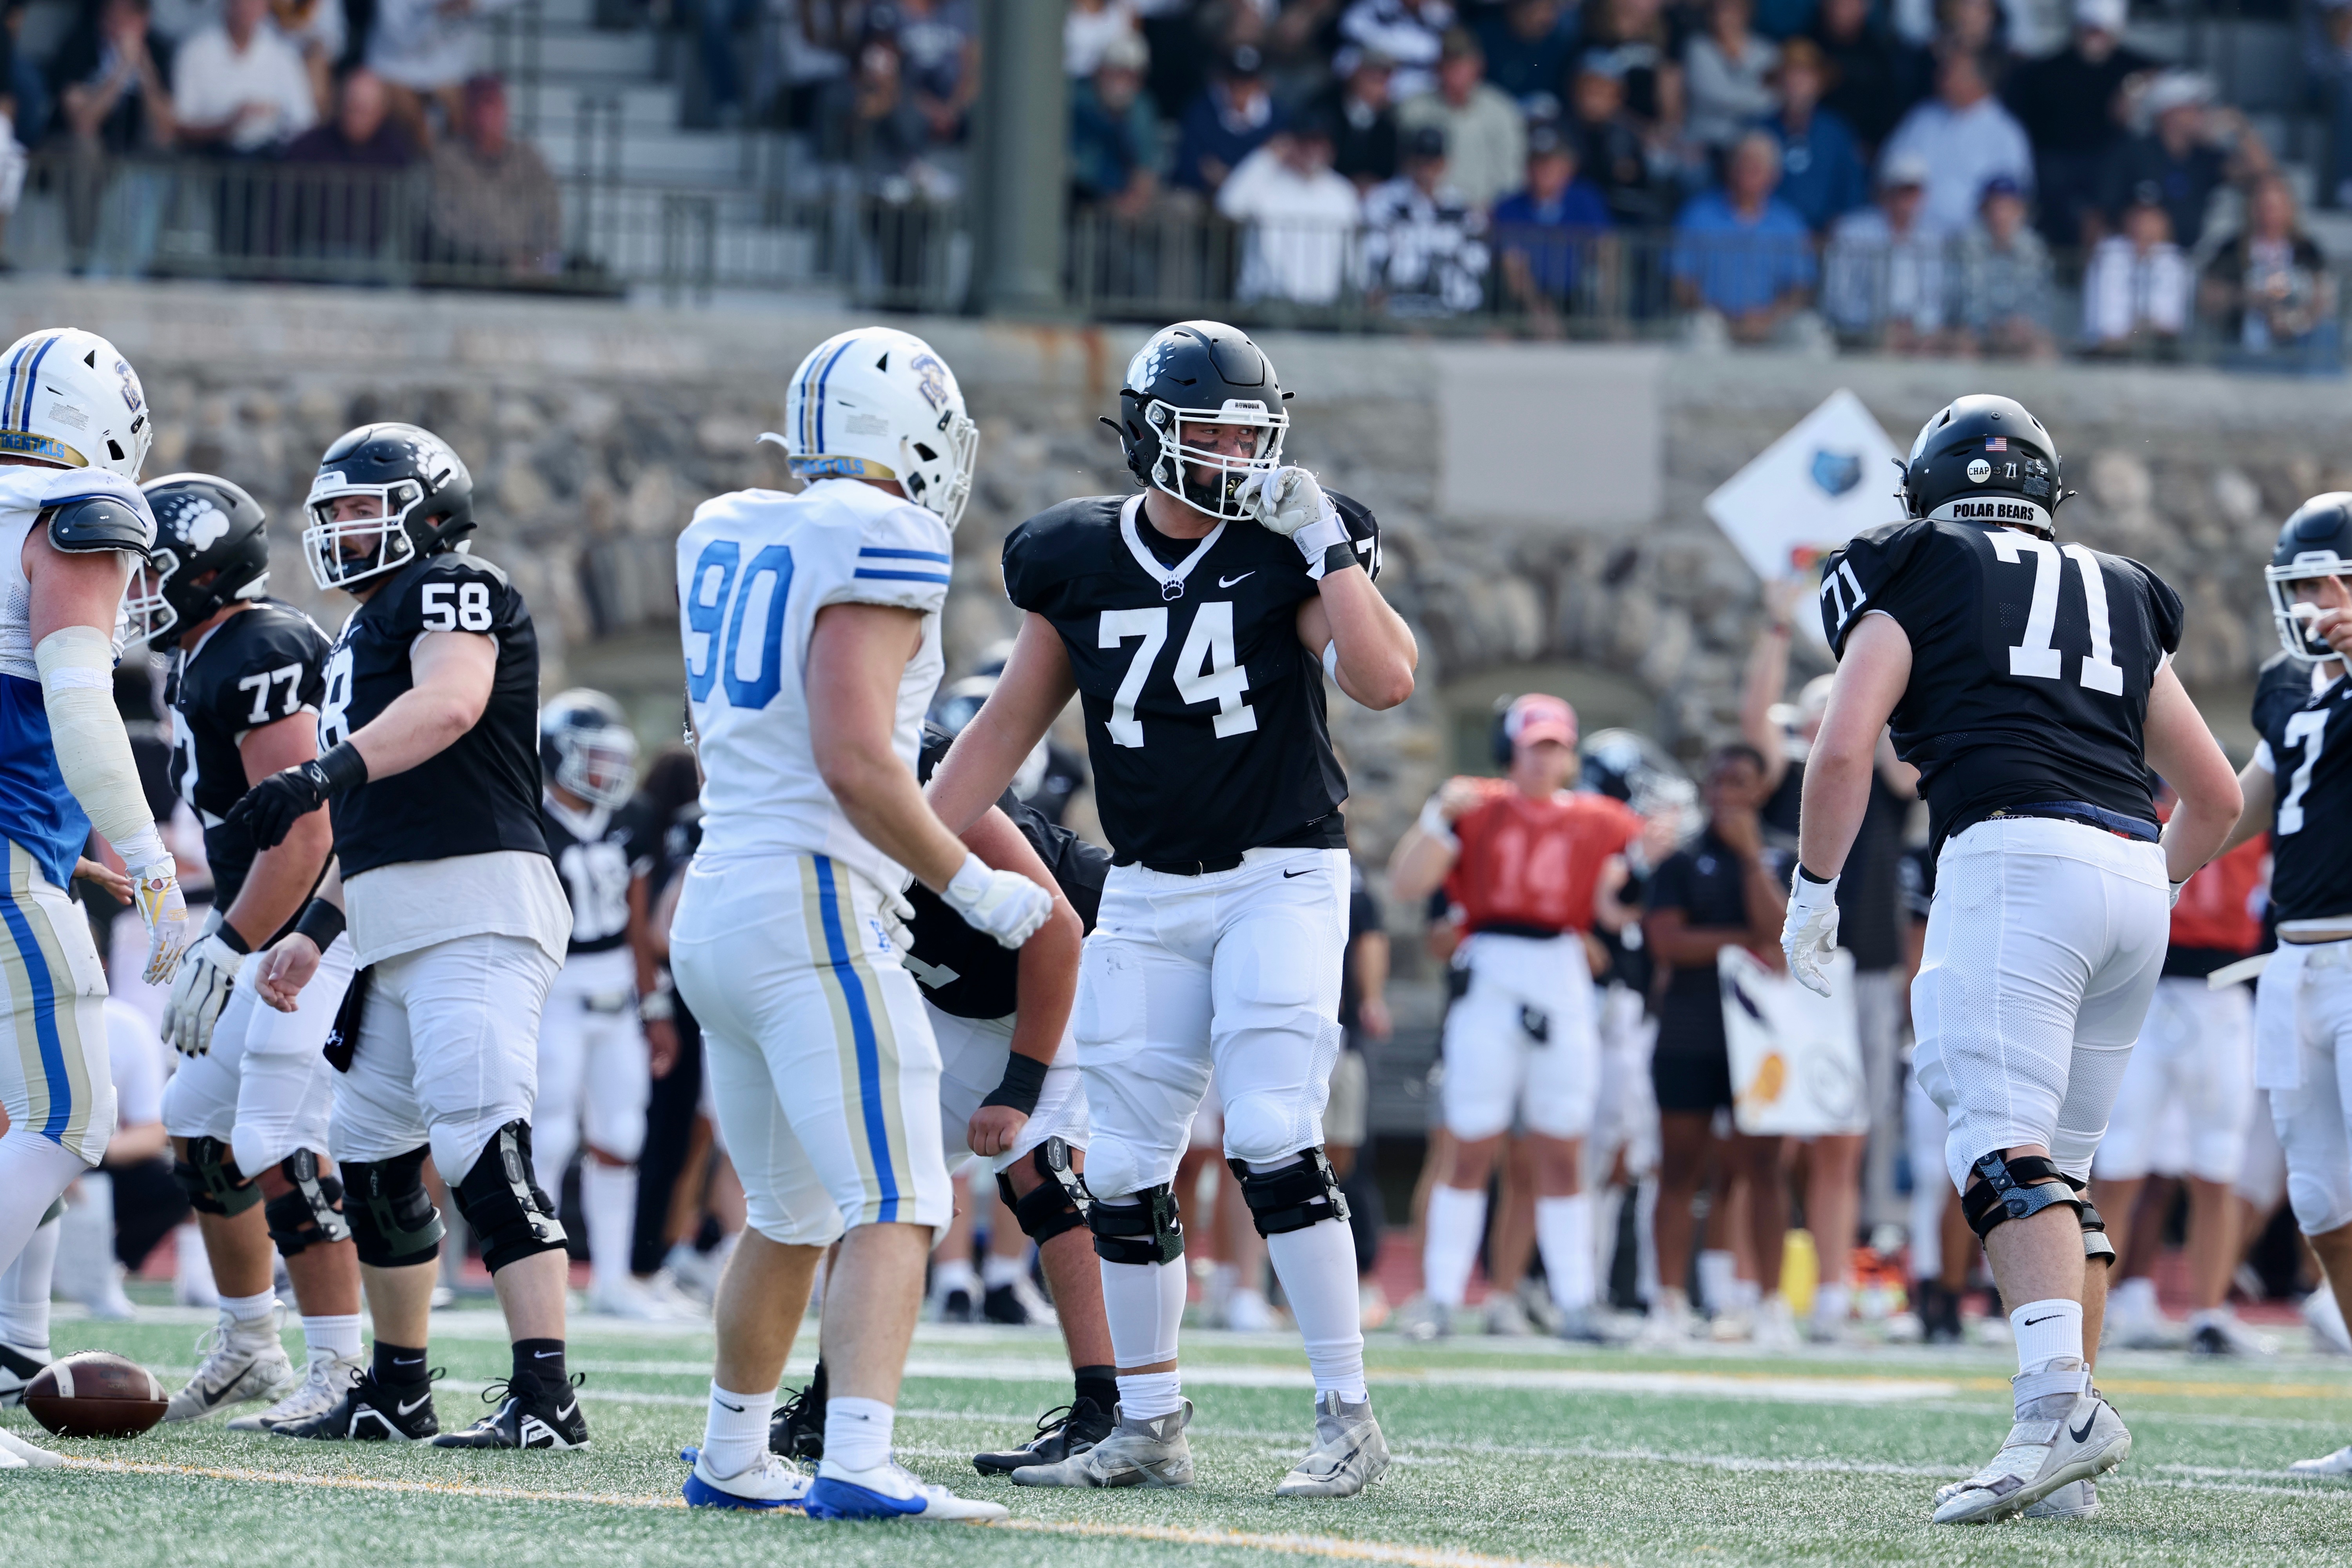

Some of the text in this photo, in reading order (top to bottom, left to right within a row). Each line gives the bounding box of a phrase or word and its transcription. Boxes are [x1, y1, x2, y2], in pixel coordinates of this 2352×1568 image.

[0, 433, 65, 458] INENTALS
[1969, 466, 1989, 475] CHAP
[2006, 463, 2016, 478] 71
[1953, 503, 2034, 521] POLAR BEARS
[422, 582, 493, 632] 58
[686, 539, 795, 710] 90
[1820, 558, 1867, 631] 71
[1984, 530, 2123, 697] 71
[238, 662, 303, 724] 77
[1098, 601, 1258, 748] 74
[2278, 708, 2331, 836] 7
